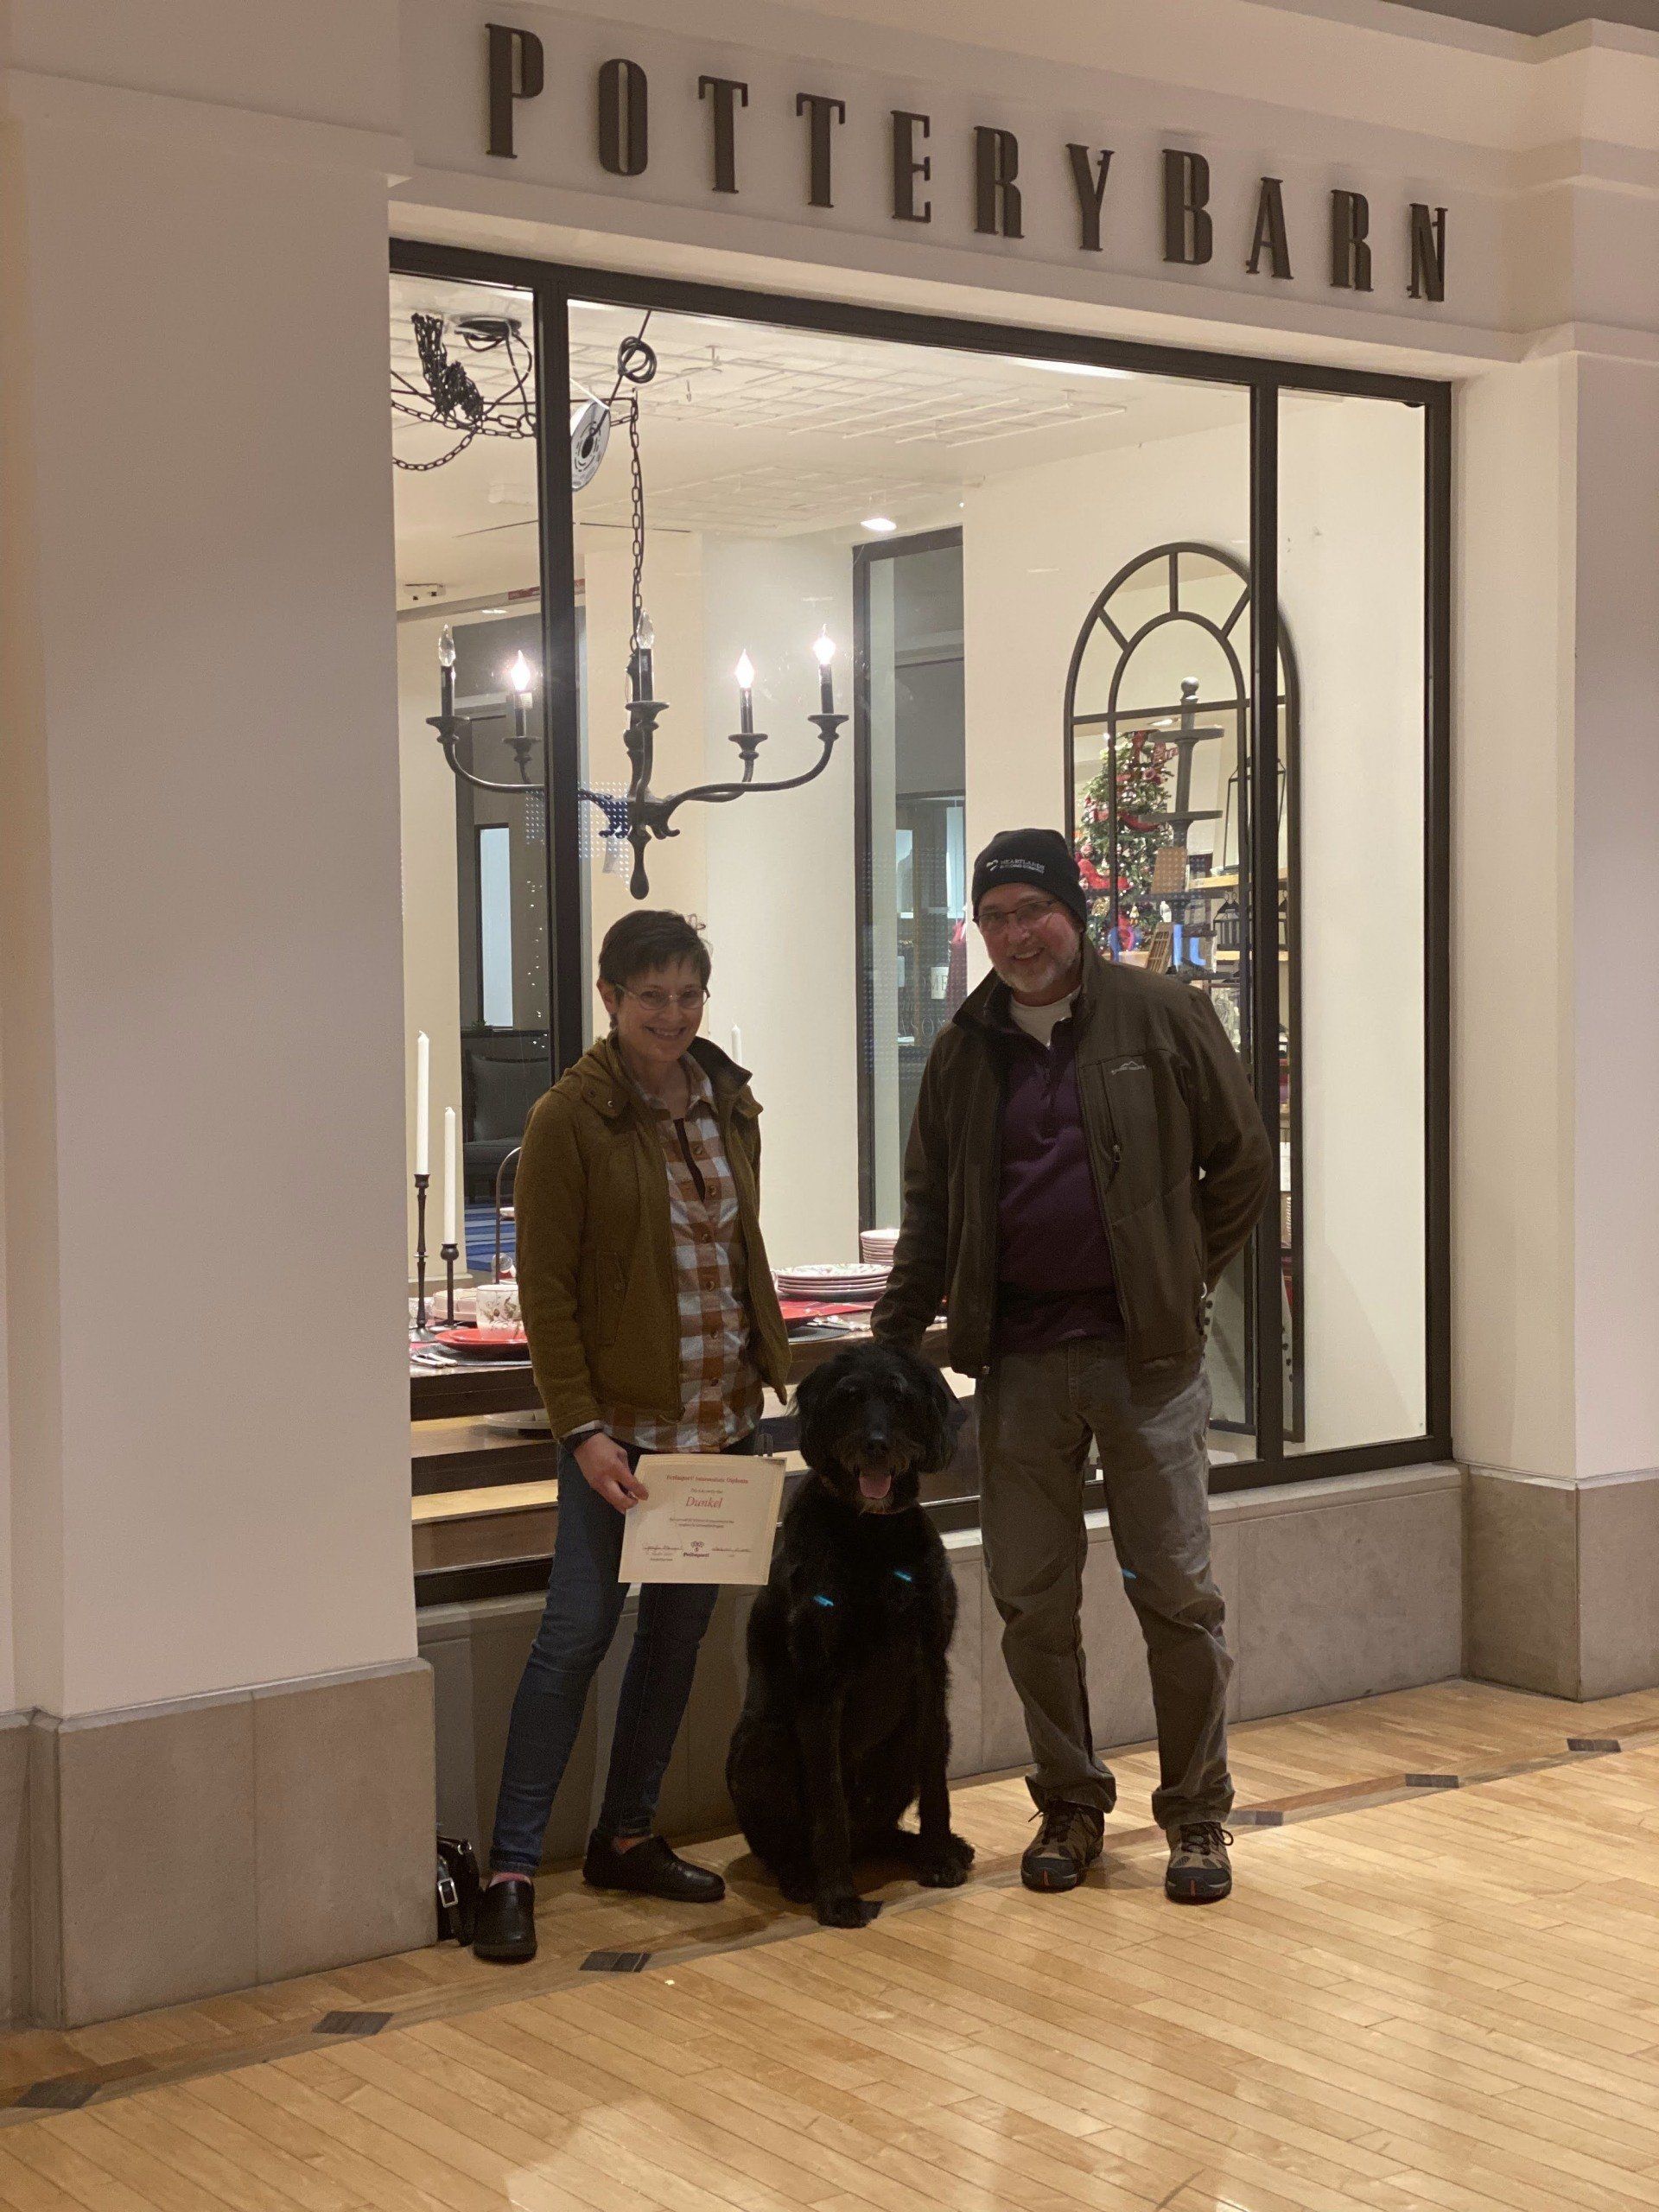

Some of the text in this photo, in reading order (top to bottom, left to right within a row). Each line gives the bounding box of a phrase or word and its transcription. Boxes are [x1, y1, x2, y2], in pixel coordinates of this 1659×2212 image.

[485, 23, 1449, 302] POTTERY BARN
[685, 1497, 723, 1509] Dunkel
